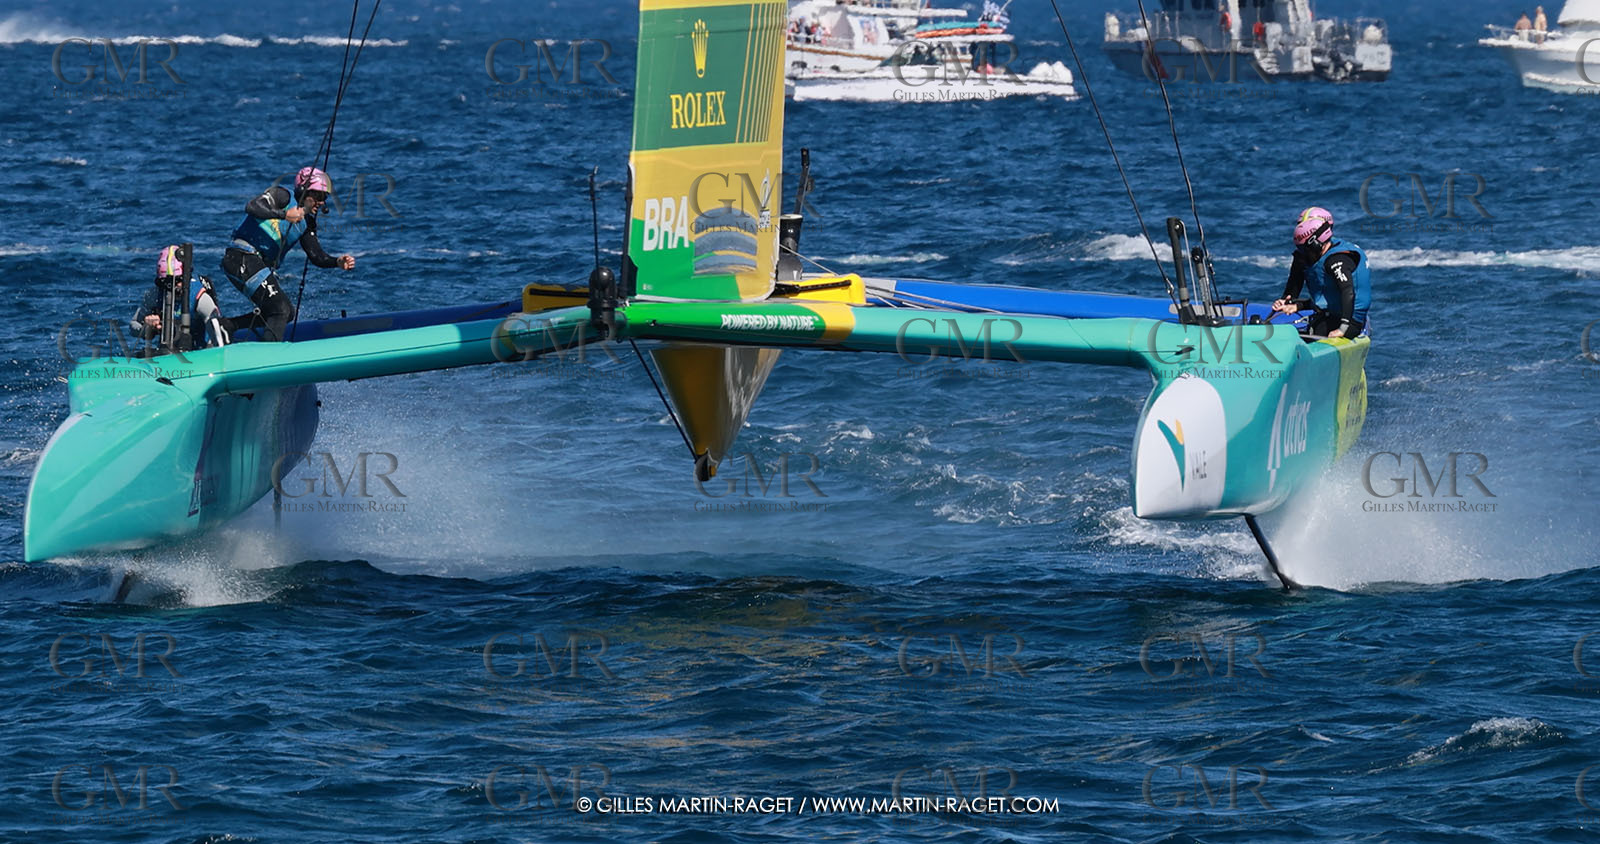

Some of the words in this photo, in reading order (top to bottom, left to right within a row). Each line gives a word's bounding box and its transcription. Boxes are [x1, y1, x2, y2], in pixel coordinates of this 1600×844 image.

[670, 91, 726, 128] ROLEX
[643, 196, 689, 251] BRA
[721, 314, 766, 329] POWERED
[766, 315, 778, 329] BY
